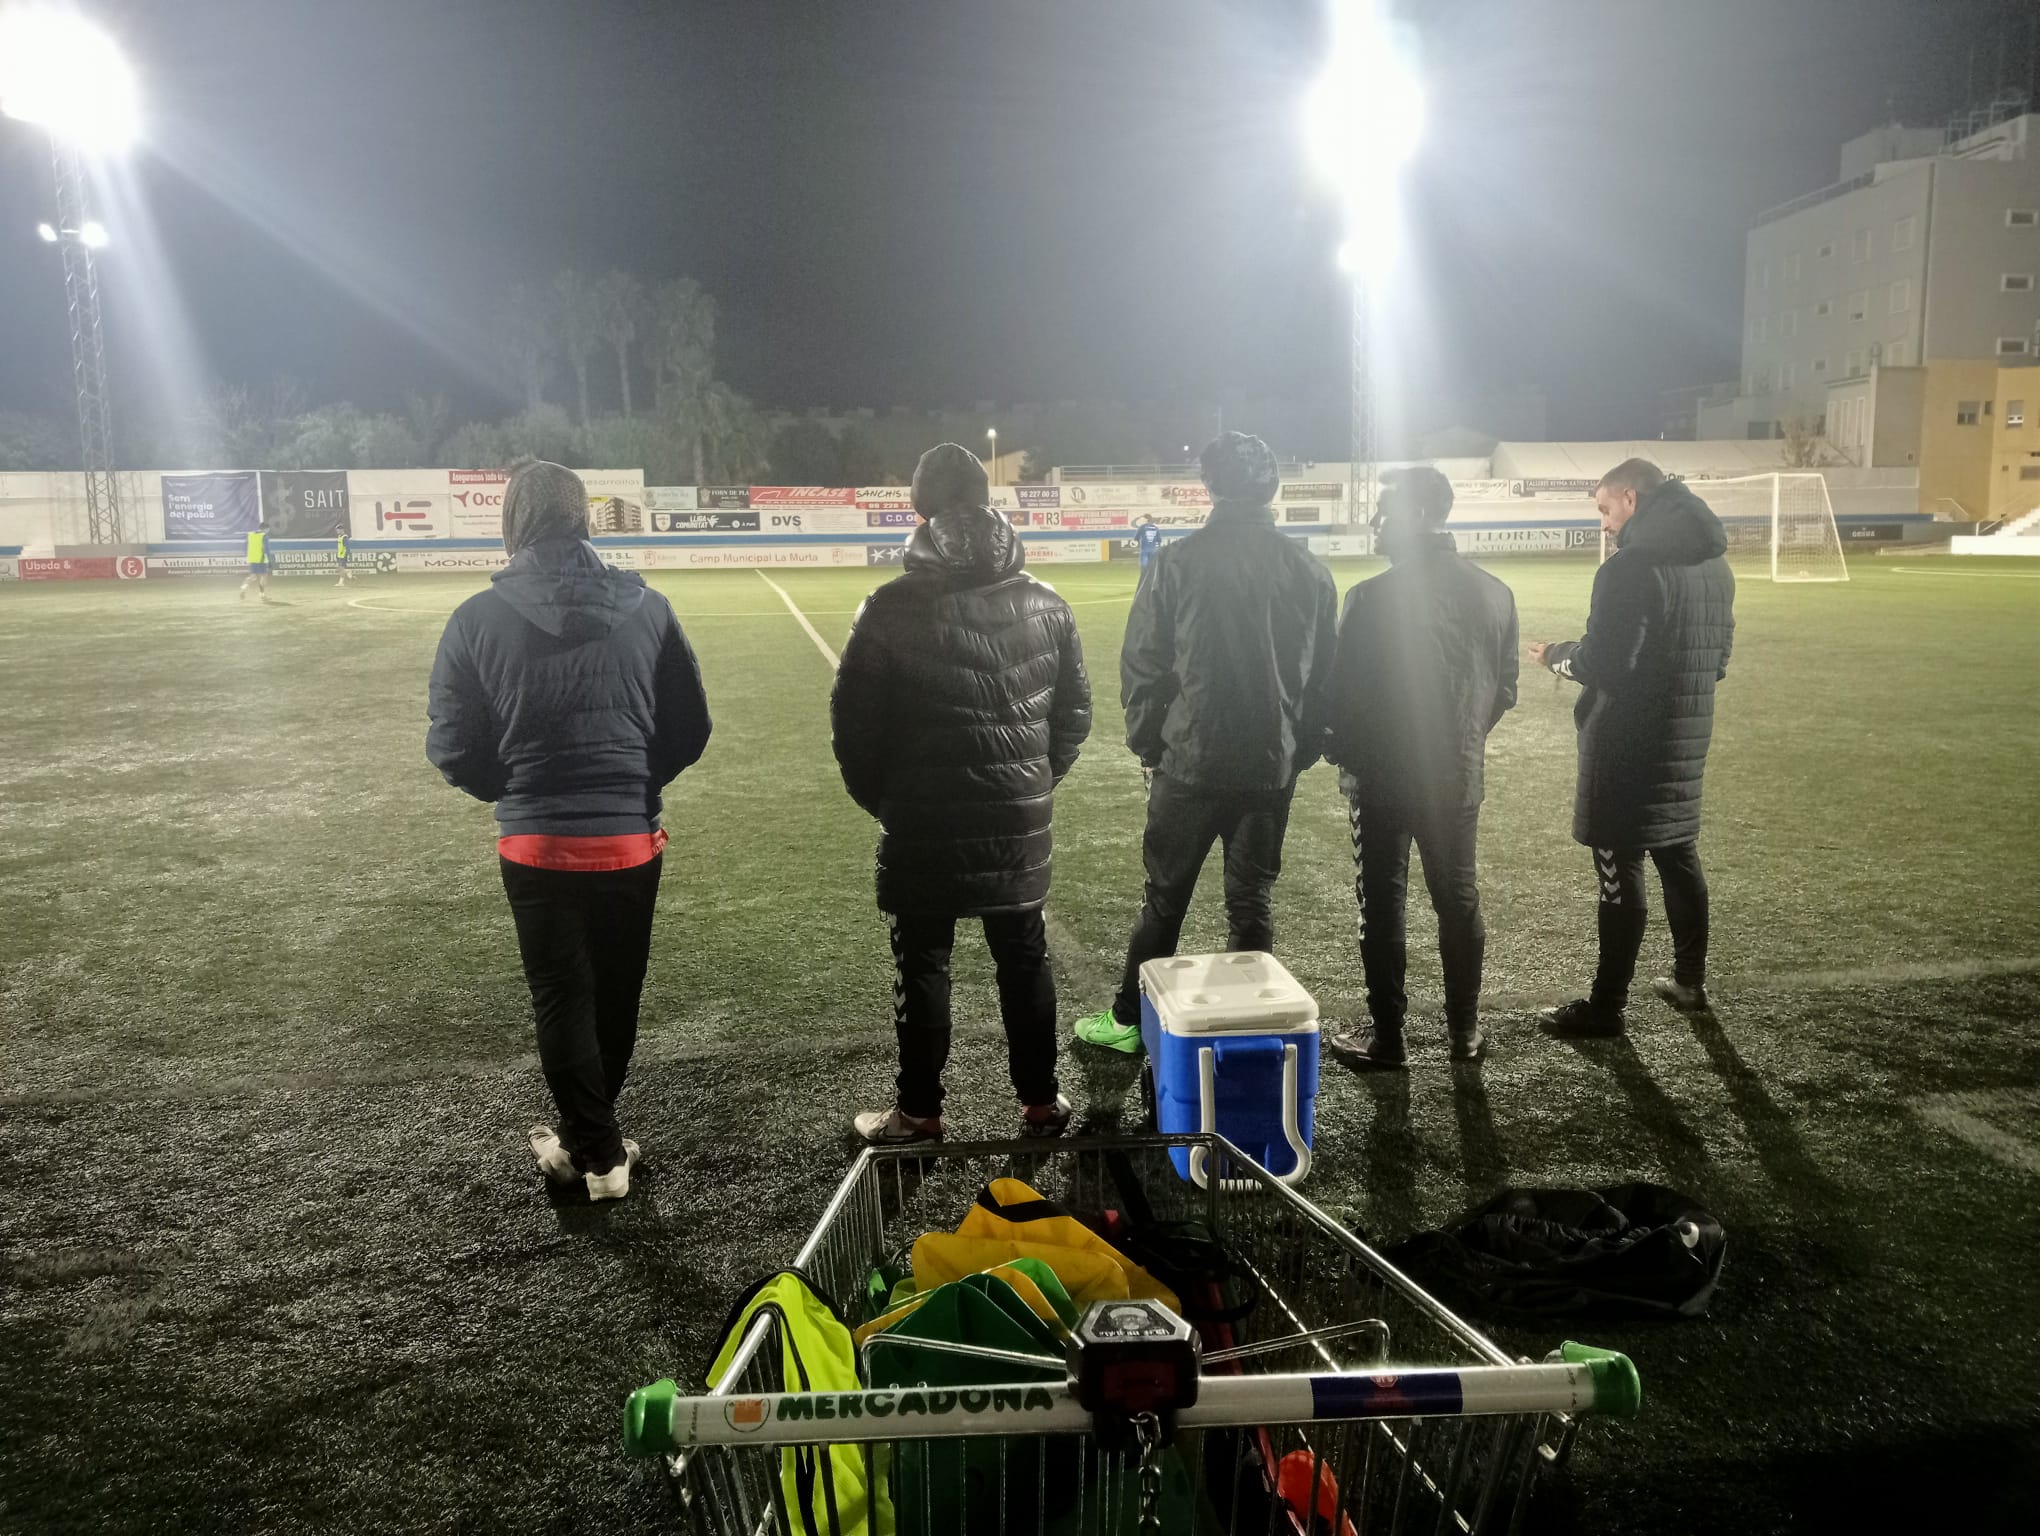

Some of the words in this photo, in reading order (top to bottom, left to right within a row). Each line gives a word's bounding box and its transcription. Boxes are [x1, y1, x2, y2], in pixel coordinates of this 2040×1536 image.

[788, 487, 849, 497] INCASE
[855, 489, 902, 498] SANCHIS
[168, 494, 191, 503] Som
[304, 489, 344, 508] SAIT
[169, 511, 186, 519] del
[187, 510, 215, 521] poble
[771, 515, 802, 526] DVS
[1046, 511, 1060, 526] R3
[1475, 530, 1562, 542] LLORENS
[1567, 530, 1585, 548] JB
[161, 558, 205, 567] Antonio
[274, 552, 329, 563] RECICLADOS
[689, 553, 720, 564] Camp
[723, 551, 772, 564] Municipal
[774, 551, 788, 562] La
[789, 551, 819, 562] Murta
[776, 1386, 1054, 1422] MERCADONA
